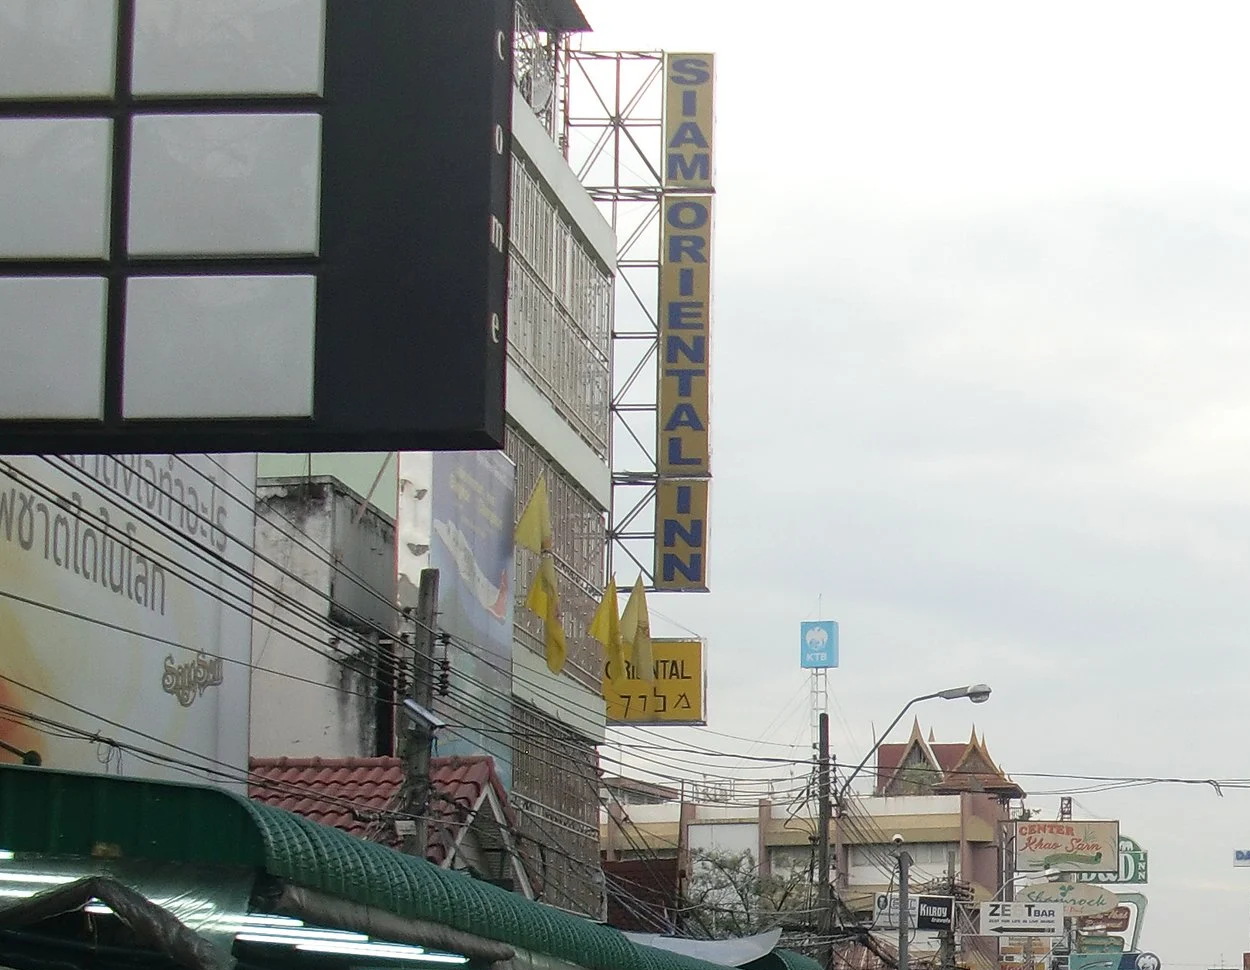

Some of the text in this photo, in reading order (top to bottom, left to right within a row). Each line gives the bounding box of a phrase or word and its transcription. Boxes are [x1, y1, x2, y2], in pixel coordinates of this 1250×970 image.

[667, 57, 712, 182] SIAM
[663, 200, 709, 468] ORIENTAL
[661, 484, 703, 583] INN
[805, 652, 829, 663] KTB
[1018, 823, 1075, 837] CENTER
[1019, 836, 1062, 852] Khao
